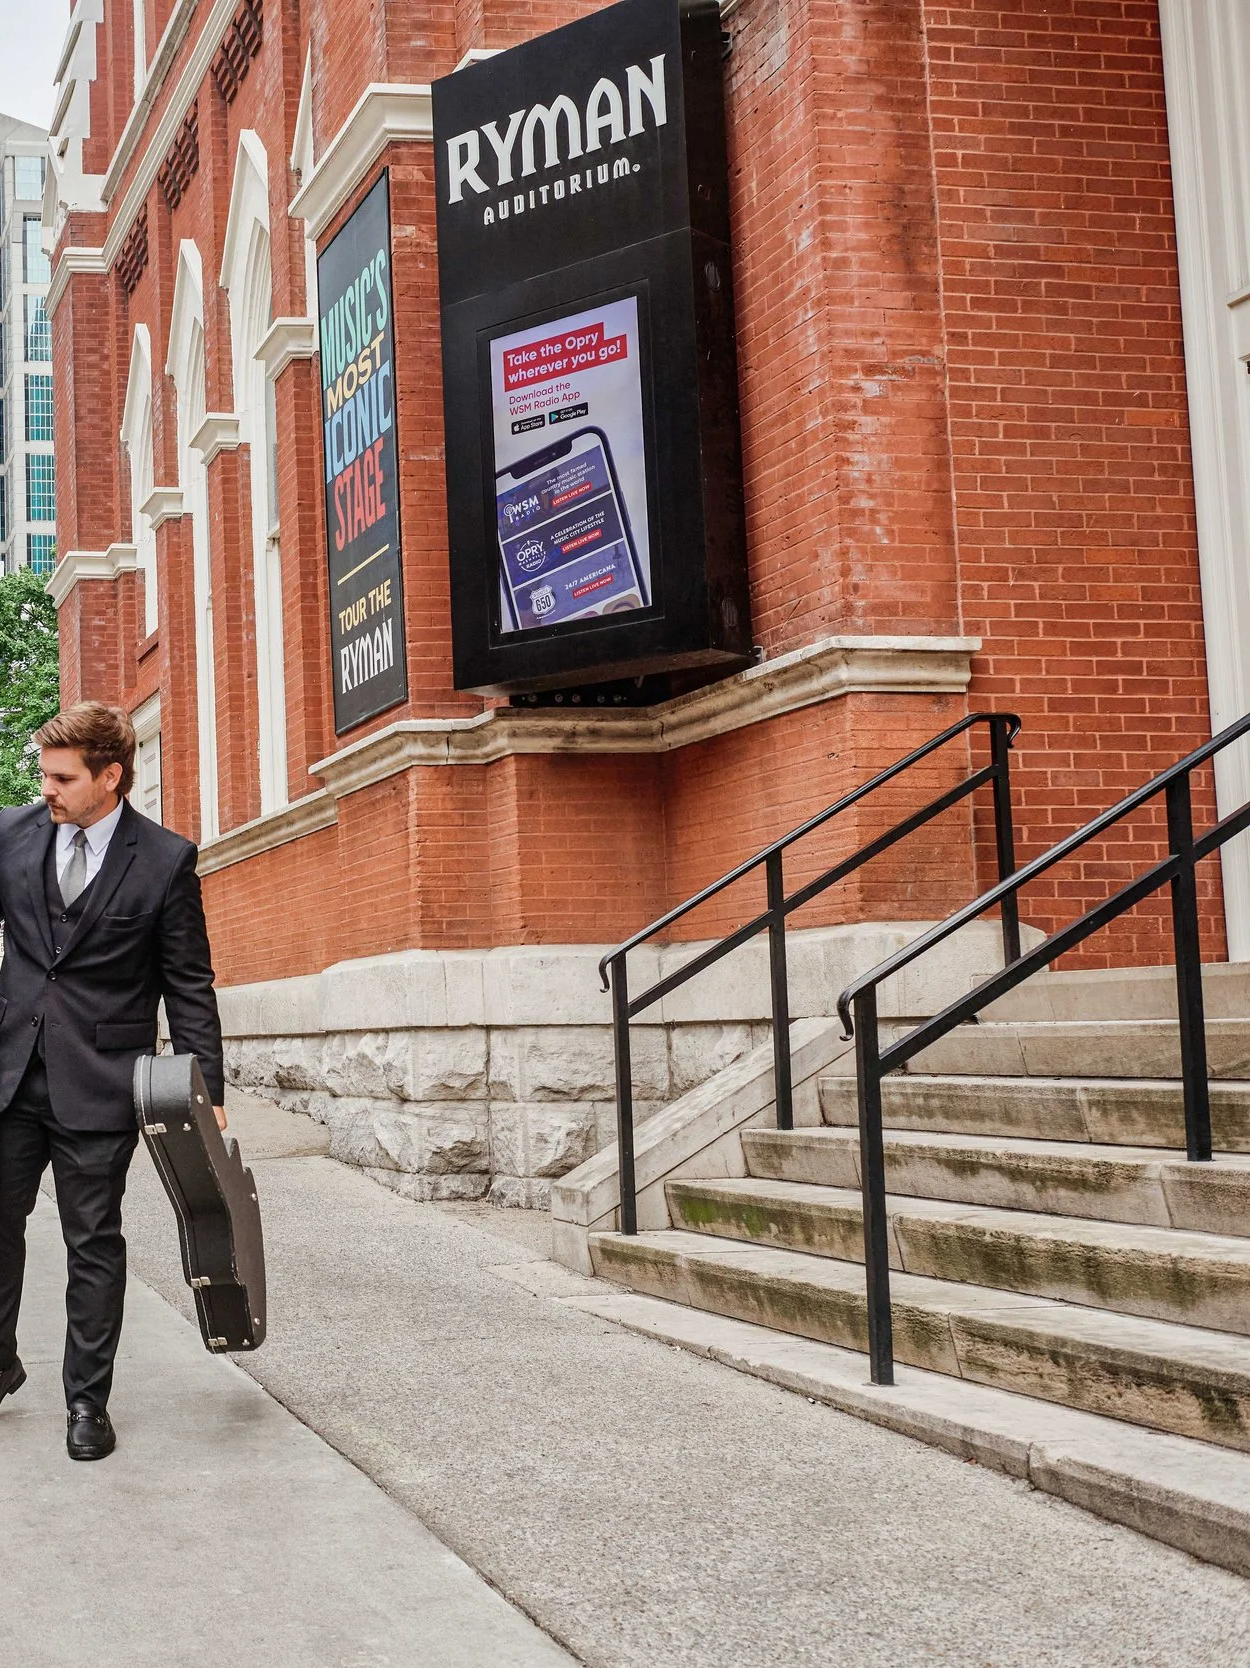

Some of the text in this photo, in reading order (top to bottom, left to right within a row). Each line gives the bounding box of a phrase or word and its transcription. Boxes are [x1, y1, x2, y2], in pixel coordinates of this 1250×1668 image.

[446, 54, 667, 204] RYMAN
[321, 248, 388, 391] MUSIC'S
[507, 332, 598, 367] Take the Opry
[508, 340, 621, 384] wherever you go!
[326, 331, 384, 419] MOST
[509, 381, 571, 405] Download the
[509, 391, 580, 416] WSM Radio App
[324, 360, 392, 484] ICONIC
[560, 411, 576, 420] Google
[541, 465, 596, 495] country music station
[546, 462, 587, 485] The most famed
[560, 484, 569, 492] the
[570, 476, 585, 487] world
[334, 437, 386, 552] STAGE
[512, 495, 539, 514] WSM
[553, 484, 590, 505] LISTEN LIVE NOW
[515, 505, 541, 521] RADIO
[553, 518, 605, 544] MUSIC CITY LIFESTYLE
[554, 519, 586, 538] CELEBRATION
[516, 541, 544, 561] OPRY
[562, 542, 577, 551] LISTEN
[587, 531, 600, 540] NOW
[526, 560, 541, 569] RADIO
[564, 564, 616, 590] 24/7 AMERICANA
[573, 577, 612, 597] LISTEN LIVE NOW
[338, 579, 391, 635] TOUR THE
[535, 594, 552, 612] 650
[340, 618, 394, 694] RYMAN
